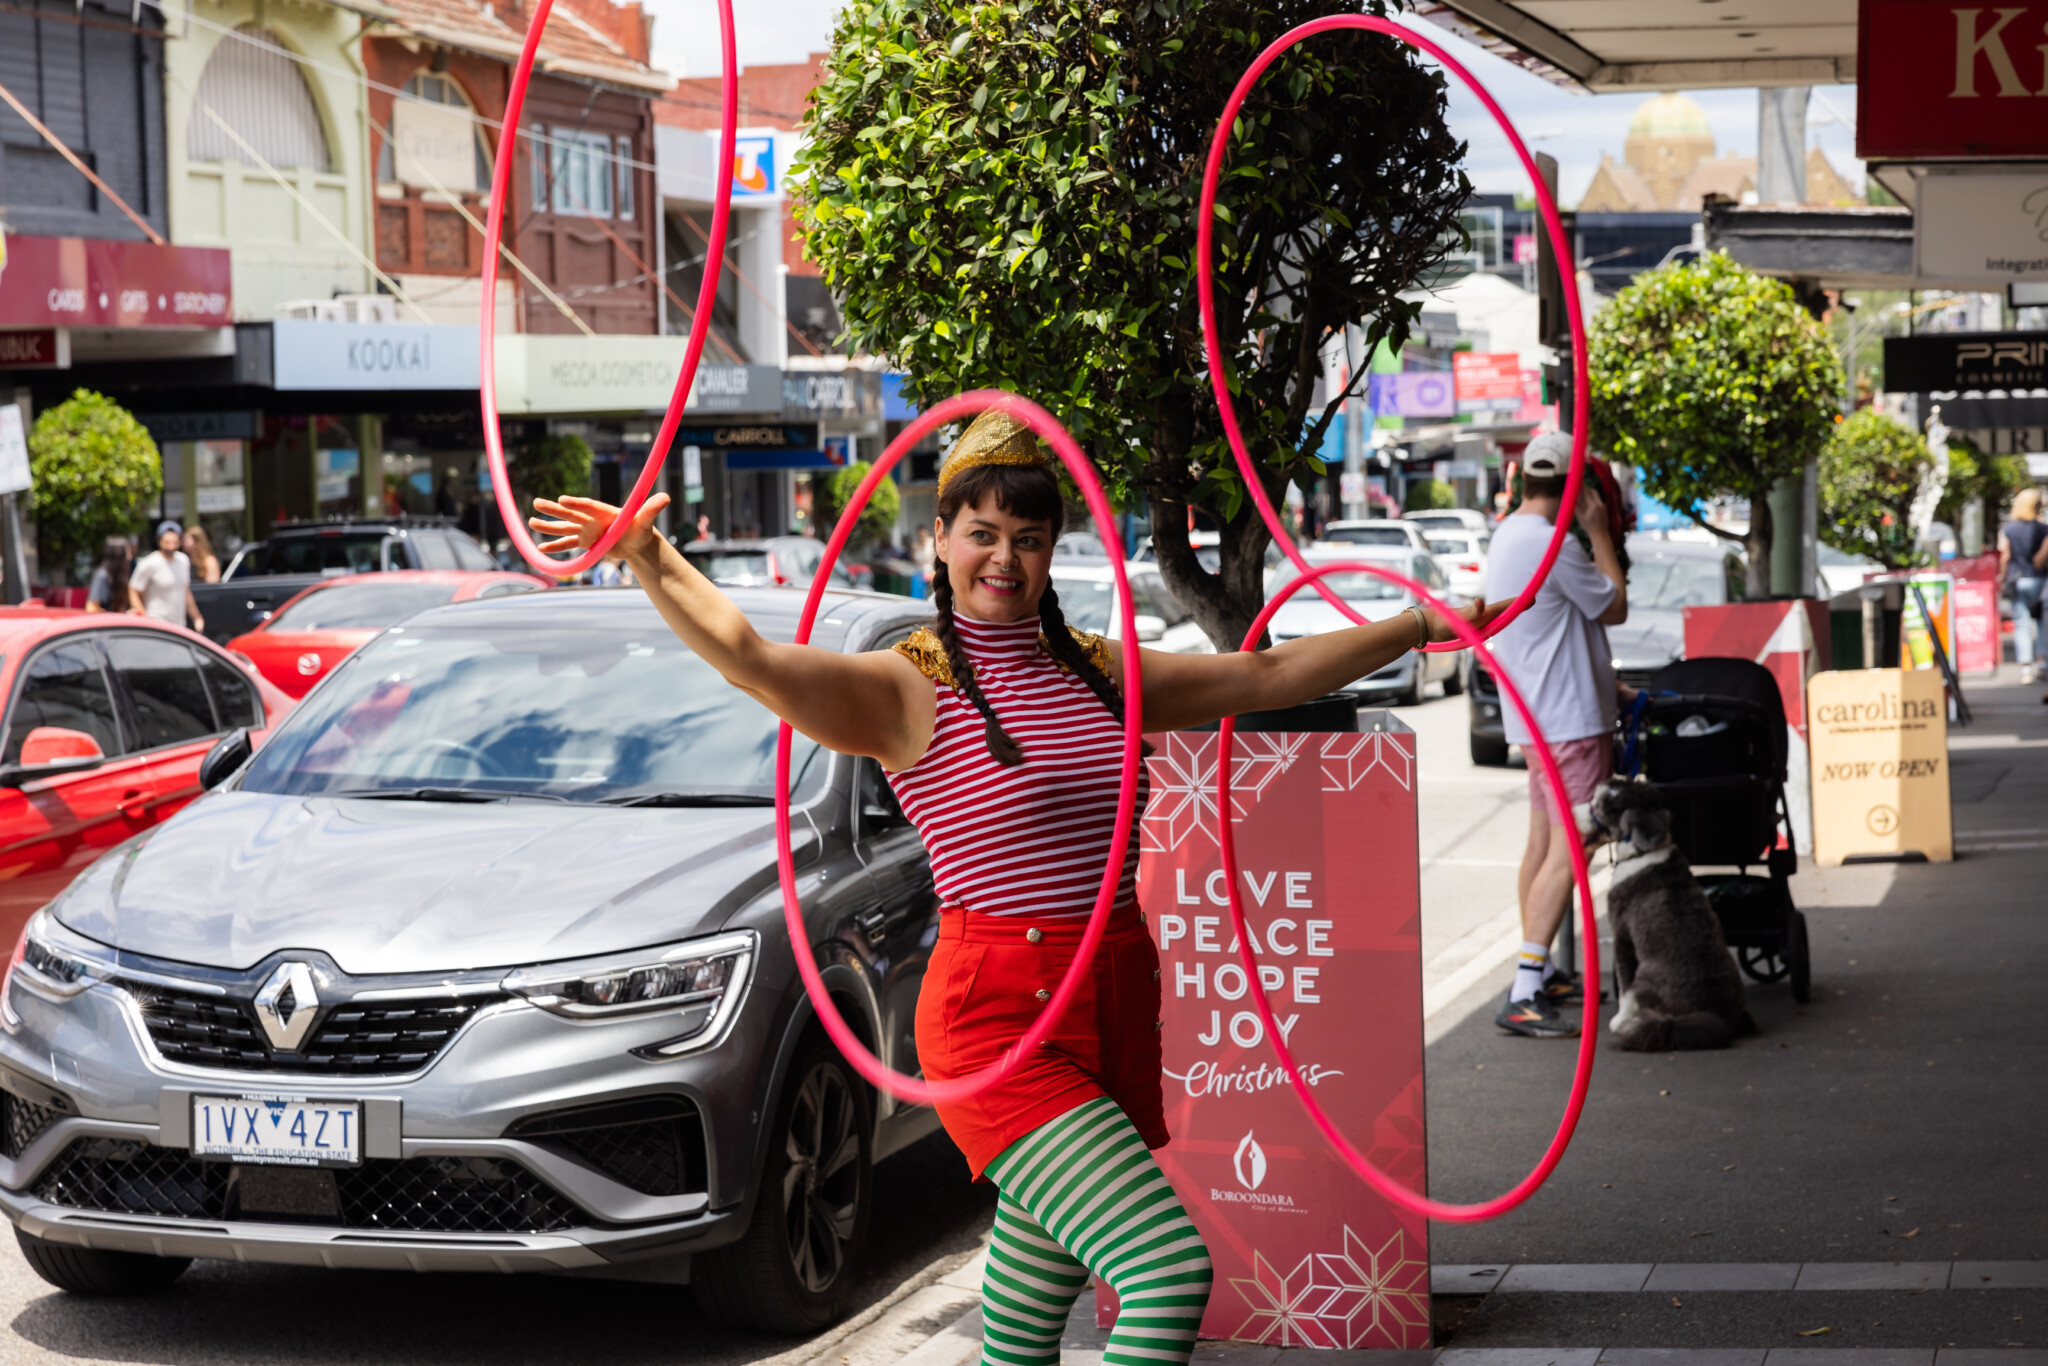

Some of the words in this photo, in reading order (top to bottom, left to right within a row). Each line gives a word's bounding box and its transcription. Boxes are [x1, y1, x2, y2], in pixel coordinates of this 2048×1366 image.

[48, 288, 85, 312] CARDS
[120, 290, 149, 313] GIFTS
[806, 376, 856, 409] CARROLL
[713, 427, 786, 445] CARROLL
[1817, 692, 1938, 724] carolina
[1822, 761, 1876, 782] NOW
[1880, 757, 1939, 779] OPEN
[1176, 868, 1313, 908] LOVE
[1160, 914, 1334, 956] PEACE
[1175, 961, 1320, 1004] HOPE
[1197, 1010, 1300, 1049] JOY
[203, 1105, 260, 1145] 1VX
[290, 1109, 353, 1149] 4ZT
[203, 1145, 244, 1155] VICTORIA
[253, 1147, 270, 1156] THE
[273, 1148, 323, 1159] EDUCATION
[326, 1151, 352, 1161] STATE
[1210, 1188, 1294, 1206] BOROONDARA
